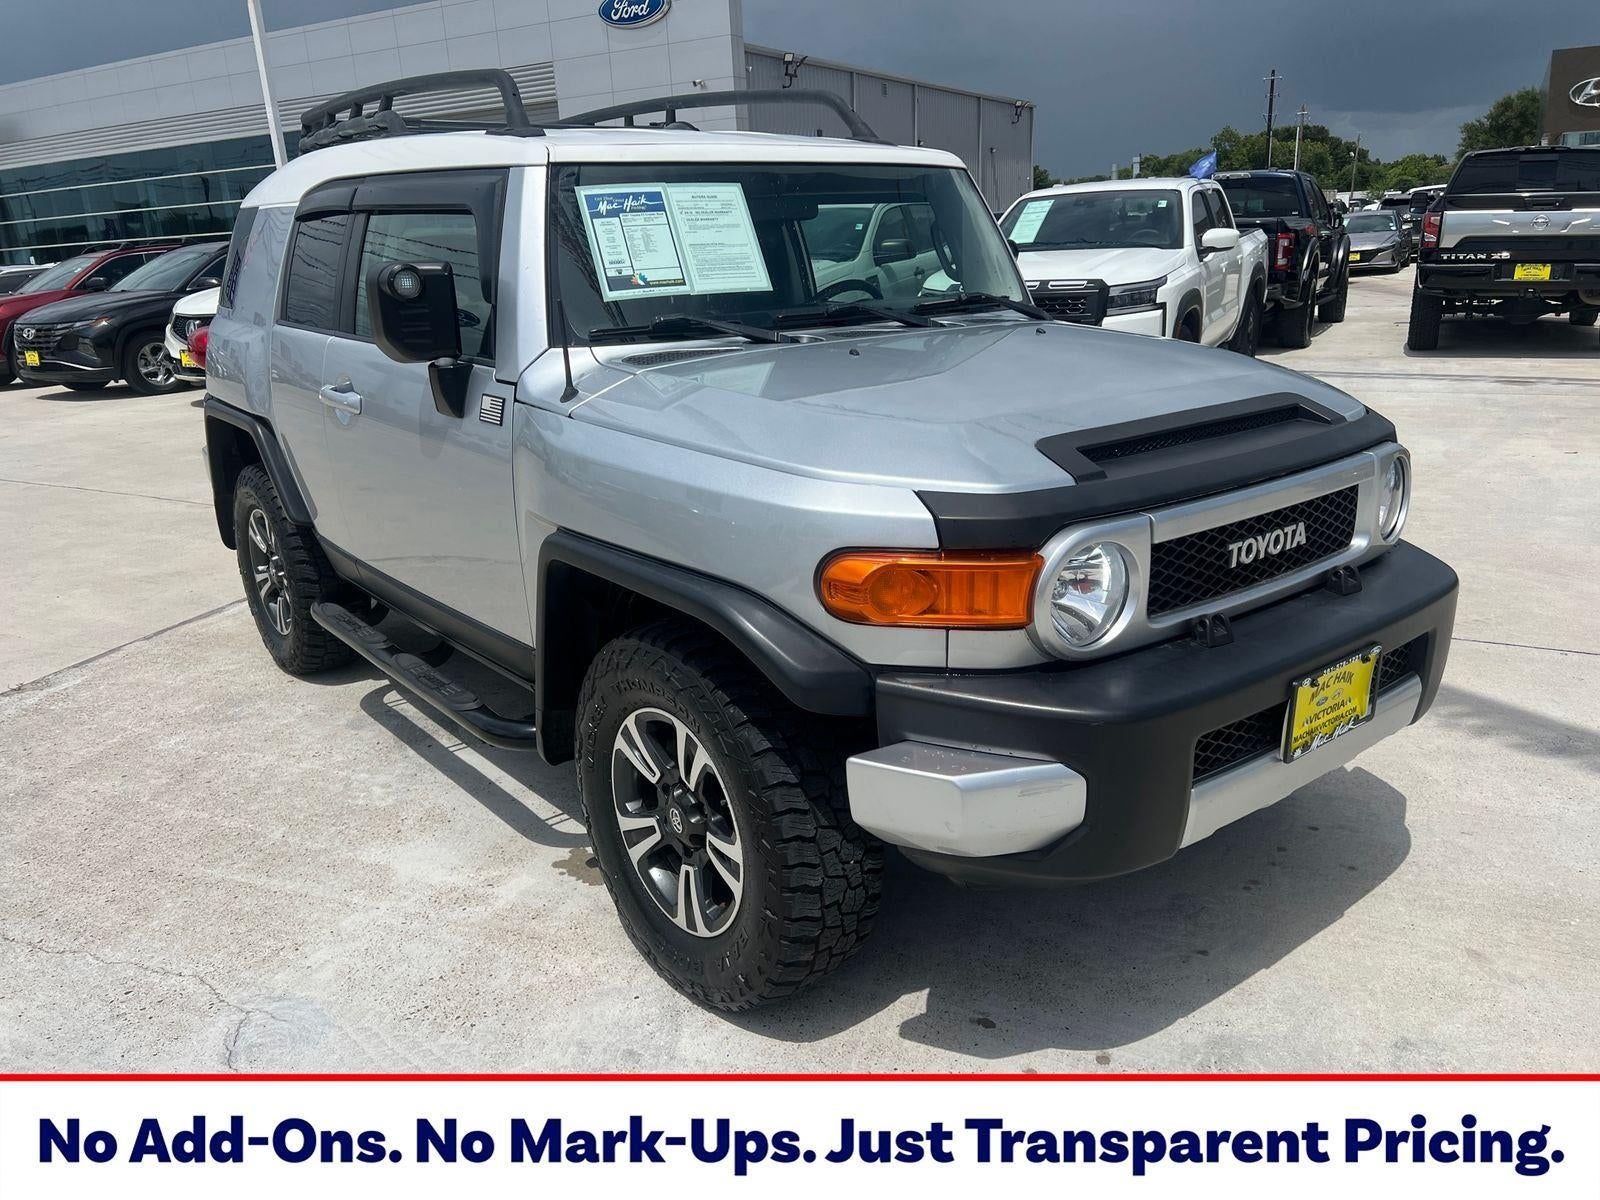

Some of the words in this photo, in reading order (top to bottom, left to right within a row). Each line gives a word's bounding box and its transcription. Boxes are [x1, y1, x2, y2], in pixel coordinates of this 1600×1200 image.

[611, 0, 650, 20] Ford
[598, 200, 622, 216] Mac
[623, 194, 647, 213] Haik
[1228, 522, 1307, 569] TOYOTA
[1308, 675, 1333, 705] MAC
[1333, 670, 1355, 686] HAIK
[1309, 699, 1346, 725] VICTORIA
